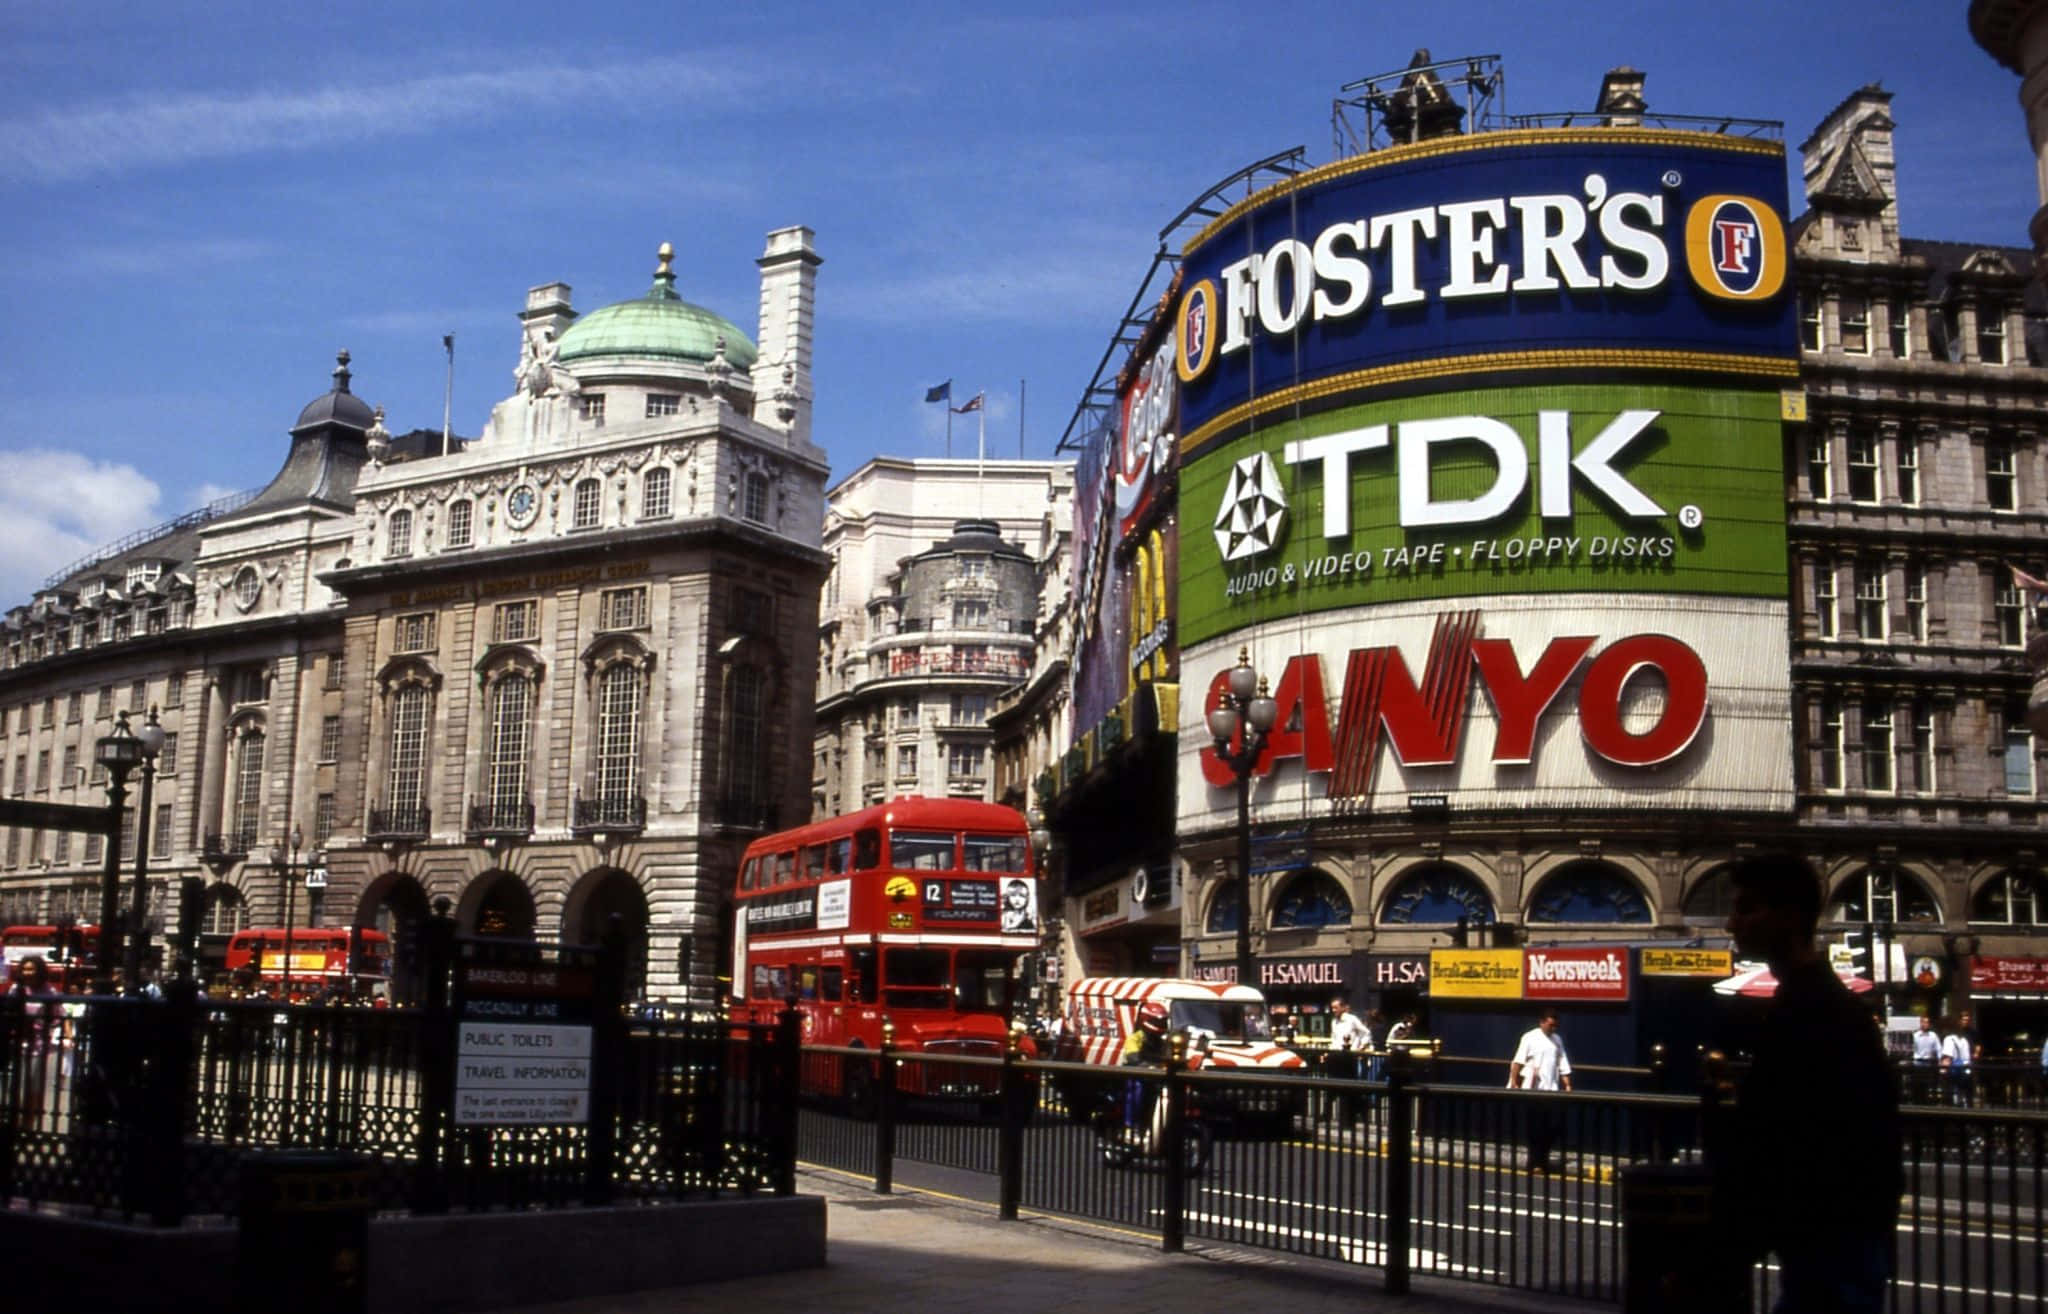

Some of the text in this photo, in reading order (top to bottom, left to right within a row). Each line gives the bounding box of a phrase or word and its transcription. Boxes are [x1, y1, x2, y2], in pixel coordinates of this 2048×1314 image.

[1221, 174, 1669, 354] FOSTER'S
[1284, 409, 1668, 539] TDK
[1225, 536, 1674, 597] AUDIO & VIDEO TAPE FLOPPY DISKS
[926, 884, 942, 902] 12
[1261, 962, 1342, 985] H.SAMUEL
[1528, 954, 1622, 981] Newsweek
[464, 1032, 553, 1048] PUBLIC TOILETS
[464, 1065, 587, 1081] TRAVEL INFORMATION
